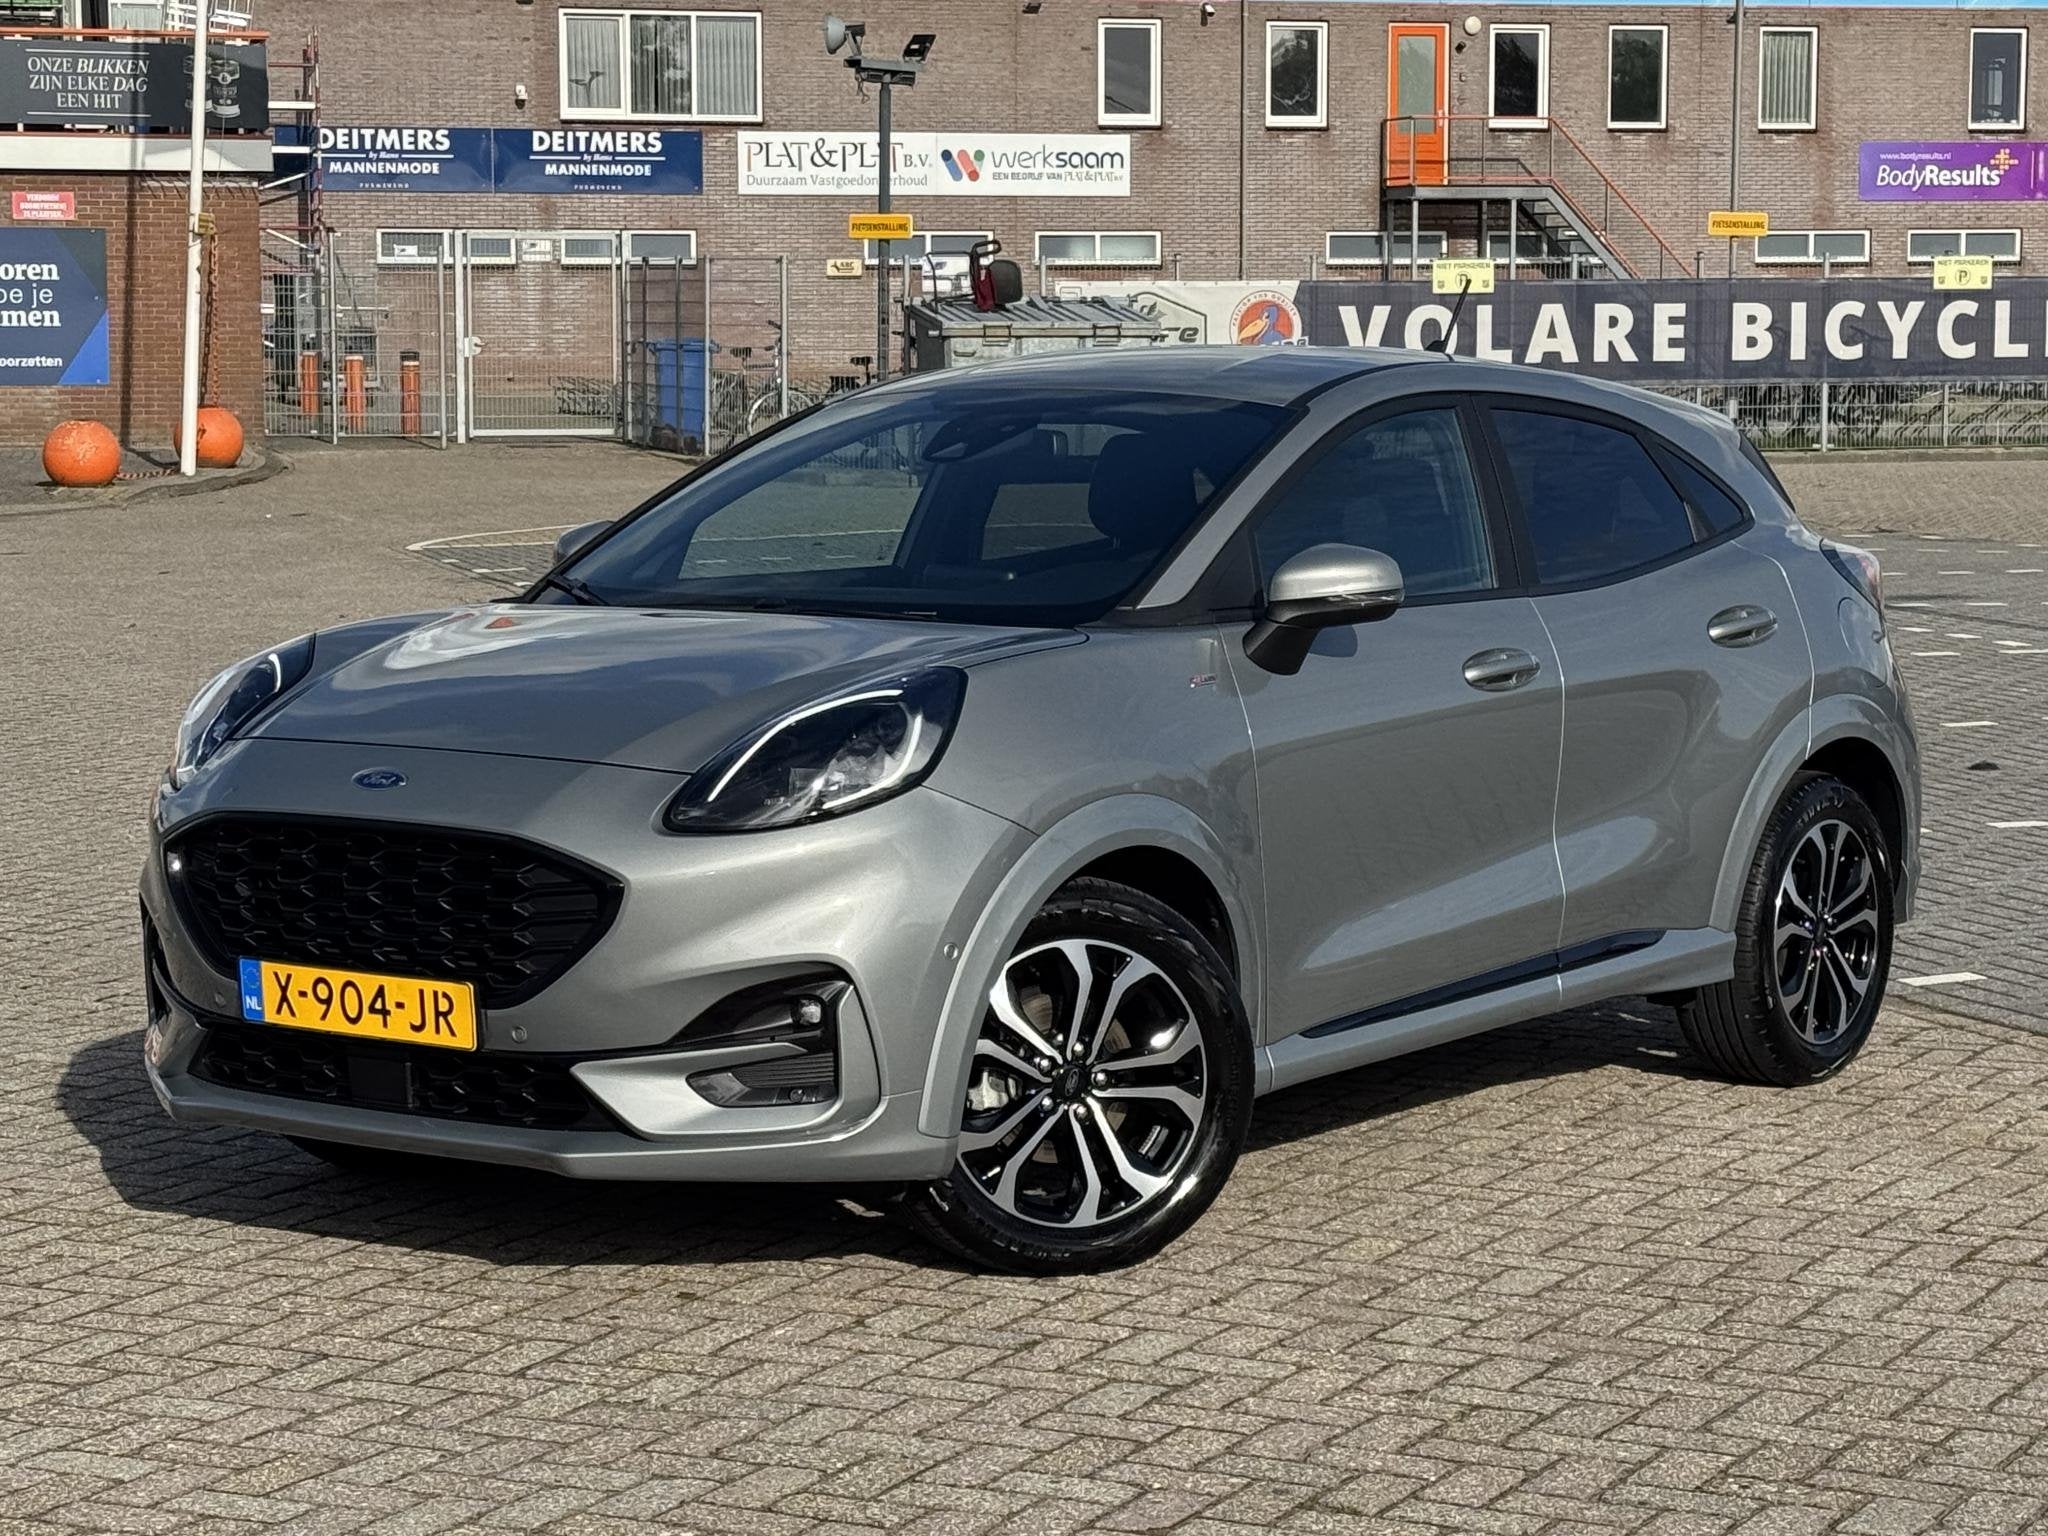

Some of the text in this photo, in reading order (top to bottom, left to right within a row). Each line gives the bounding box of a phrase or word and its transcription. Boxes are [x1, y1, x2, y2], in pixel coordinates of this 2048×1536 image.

[27, 57, 150, 75] ONZE BLIKKEN
[29, 74, 149, 92] ZIJN ELKE DAG
[57, 92, 122, 109] EEN HIT
[319, 128, 451, 151] DEITMERS
[532, 130, 663, 153] DEITMERS
[991, 143, 1125, 169] werksaam
[329, 161, 440, 175] MANNENMODE
[544, 164, 652, 176] MANNENMODE
[1876, 164, 2001, 192] BodyResults
[746, 174, 807, 187] Duurzaam
[31, 282, 54, 309] je
[1338, 300, 2048, 363] VOLARE BICYCL
[245, 970, 458, 1038] NL X-904-JR
